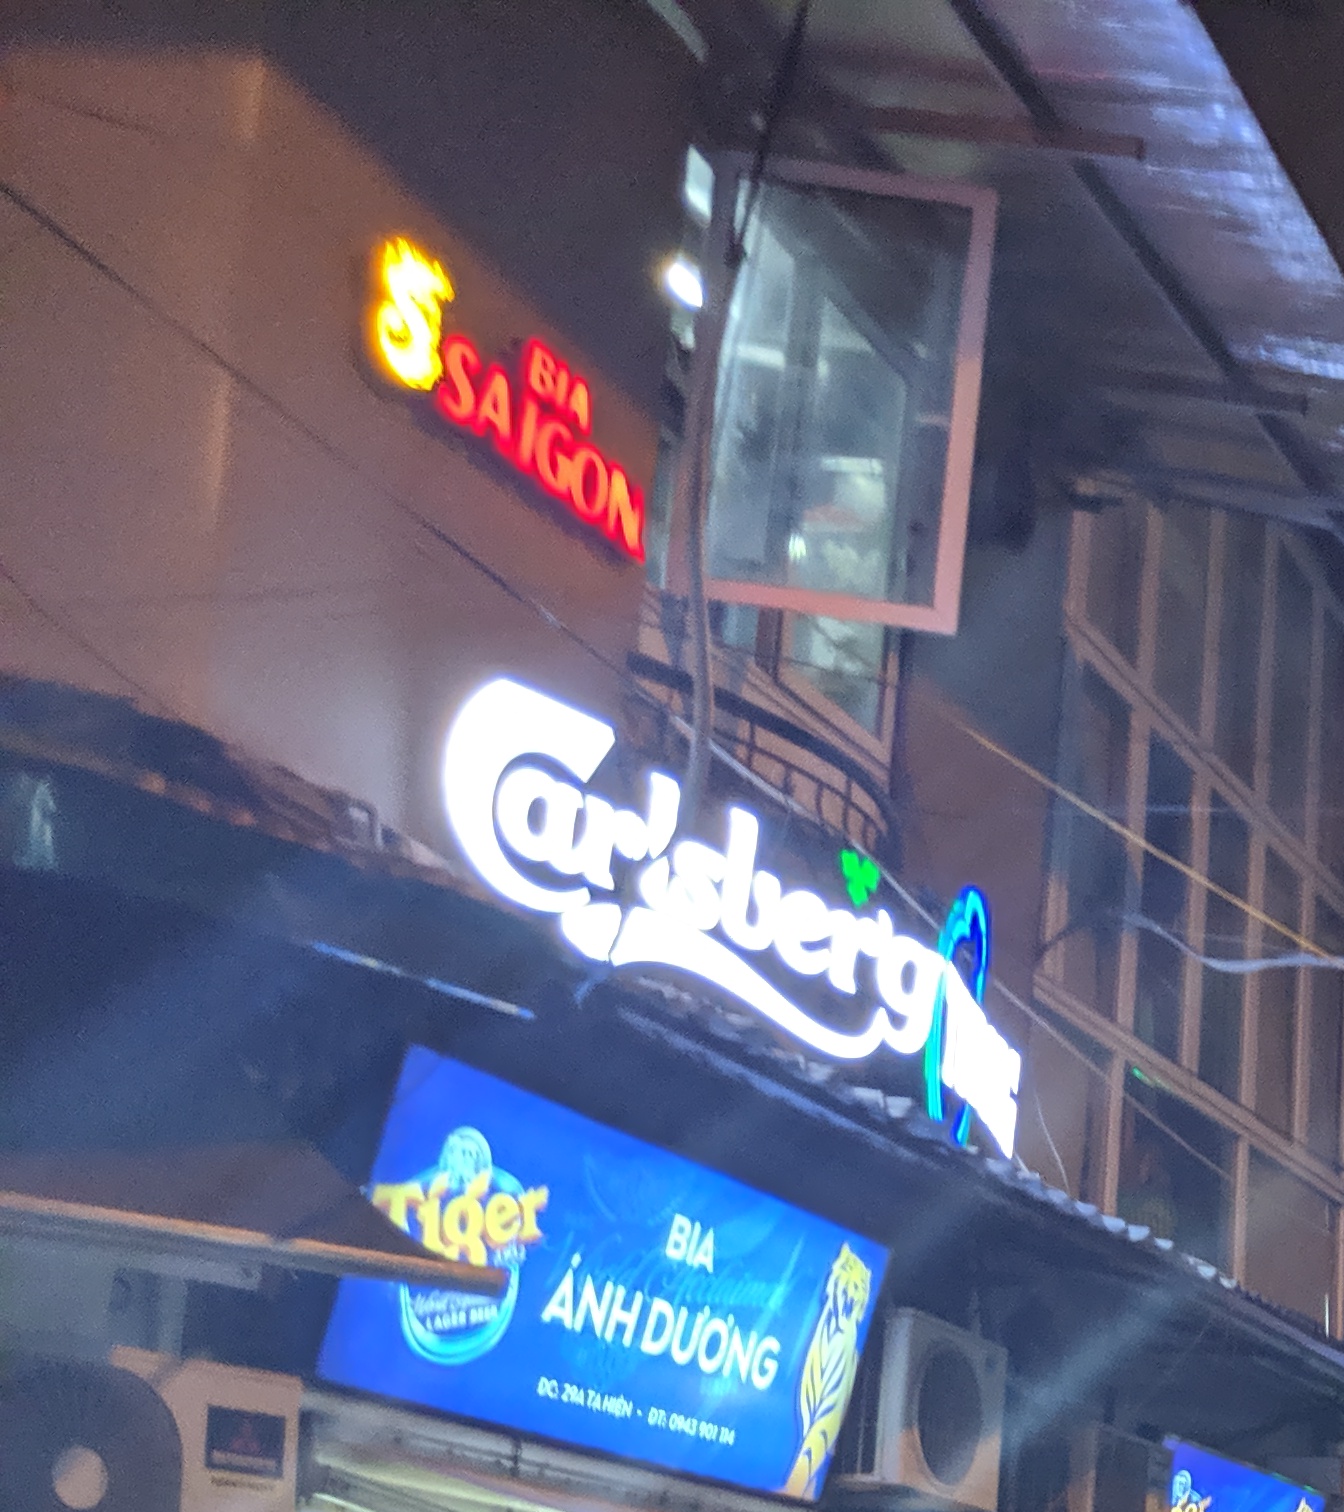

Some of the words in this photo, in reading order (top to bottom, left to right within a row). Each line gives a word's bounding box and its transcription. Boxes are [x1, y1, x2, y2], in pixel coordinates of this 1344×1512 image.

[526, 341, 593, 432] BIA
[438, 334, 645, 564] SAIGON
[443, 676, 946, 1060] Carlsberg
[372, 1169, 549, 1267] Tiger
[665, 1213, 716, 1273] BIA
[541, 1252, 641, 1347] ÁNH
[642, 1301, 781, 1390] DƯƠNG
